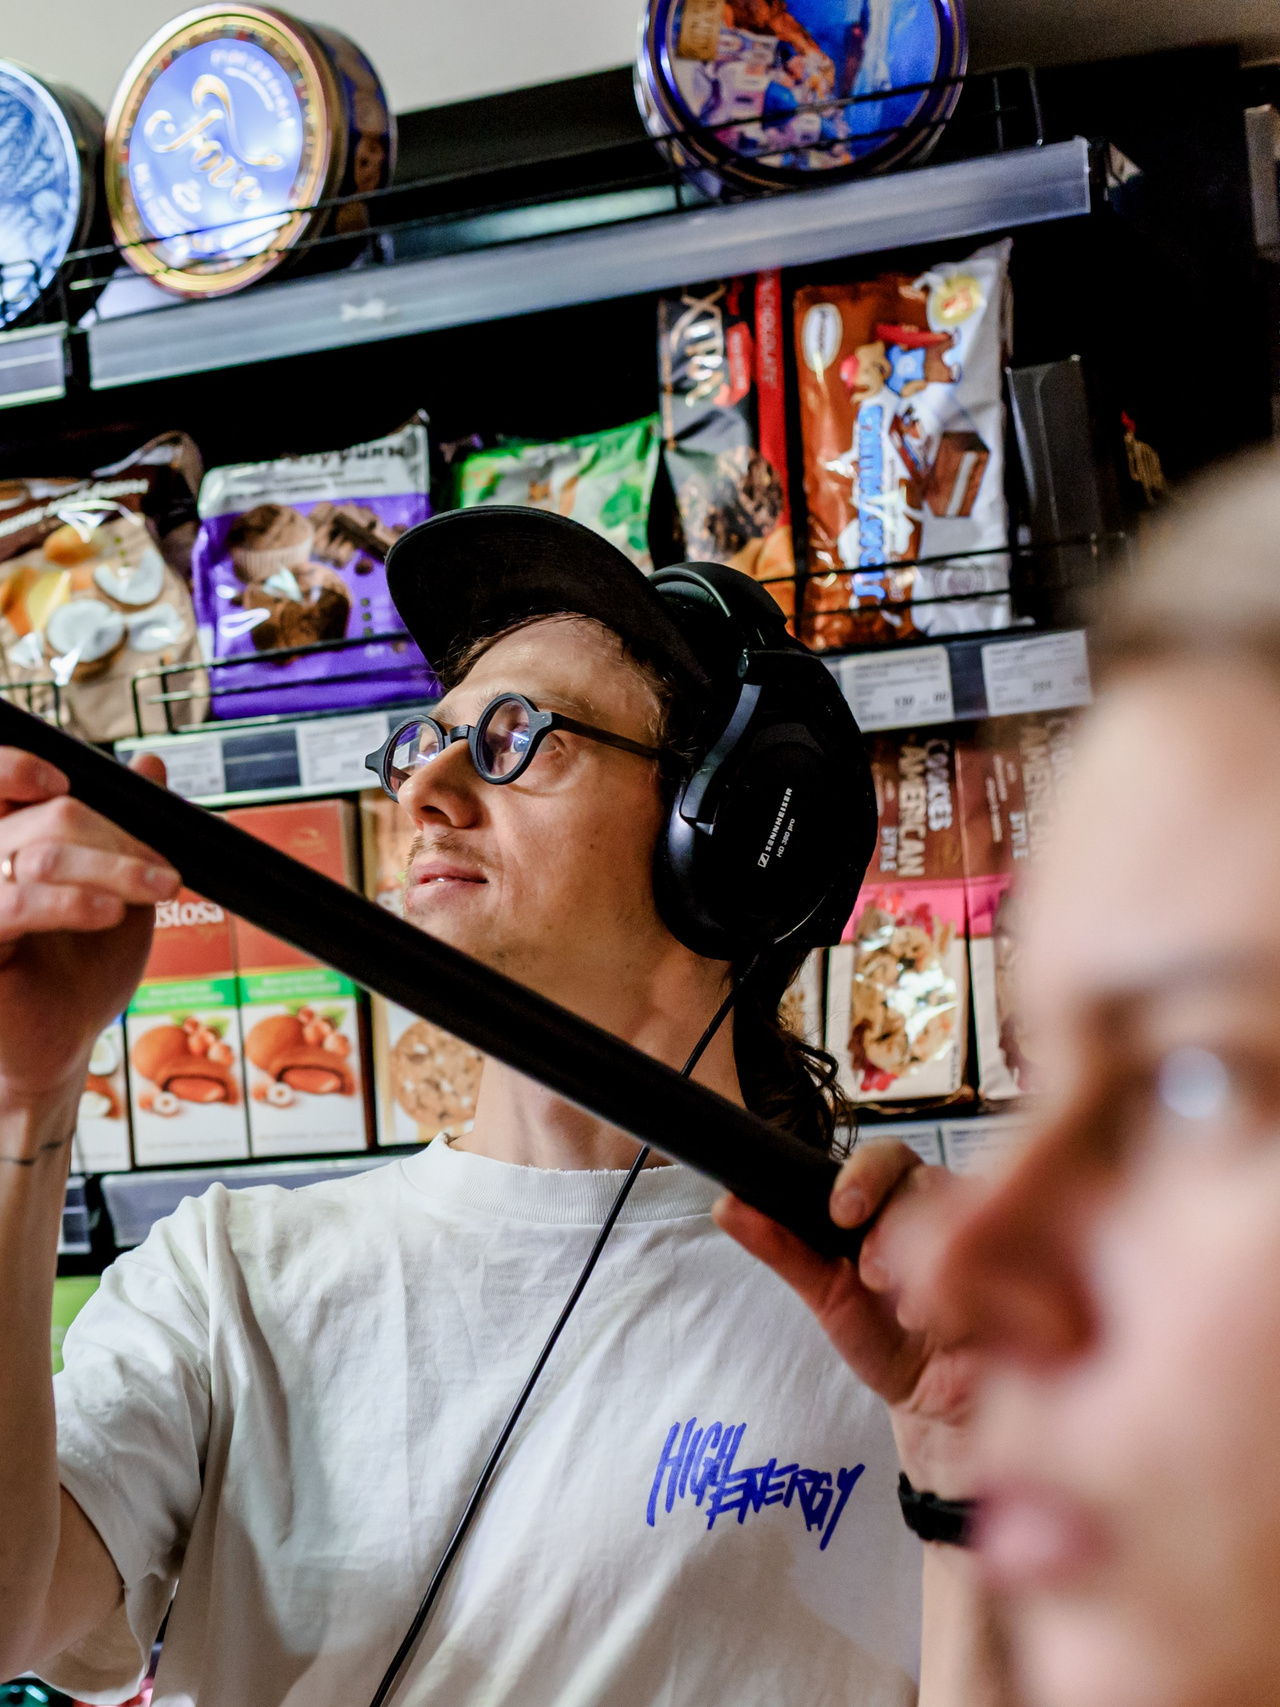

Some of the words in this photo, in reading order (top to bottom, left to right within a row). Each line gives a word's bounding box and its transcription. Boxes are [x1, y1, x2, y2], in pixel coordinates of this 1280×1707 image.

[765, 787, 793, 852] SENNHEISER
[776, 846, 786, 858] HD
[788, 818, 796, 832] pro
[647, 1417, 747, 1527] HIGH
[705, 1457, 866, 1552] ENERGY
